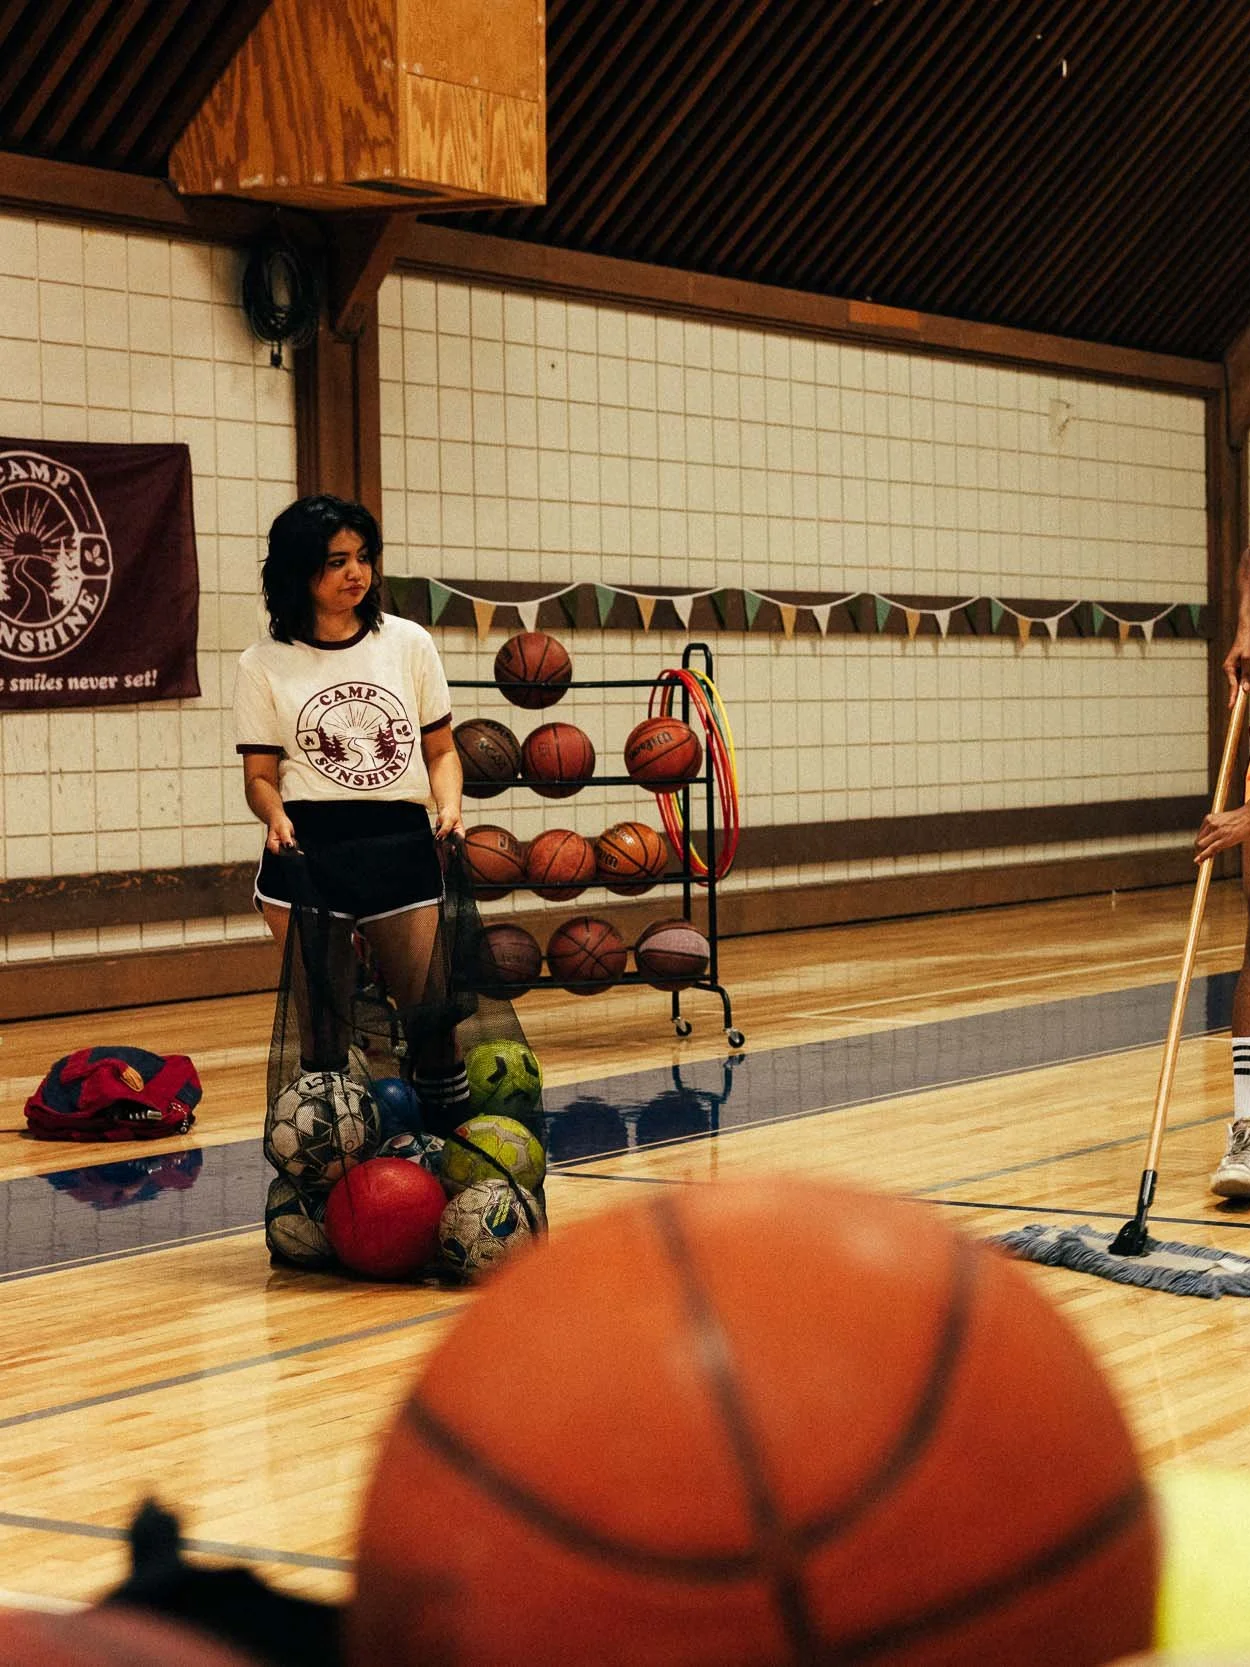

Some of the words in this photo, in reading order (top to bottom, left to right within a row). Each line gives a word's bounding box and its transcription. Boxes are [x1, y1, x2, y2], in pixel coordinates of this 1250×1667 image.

[9, 672, 63, 692] smiles
[68, 676, 119, 691] never
[124, 669, 158, 689] set!
[319, 686, 377, 706] CAMP
[315, 749, 407, 787] SUNSHINE
